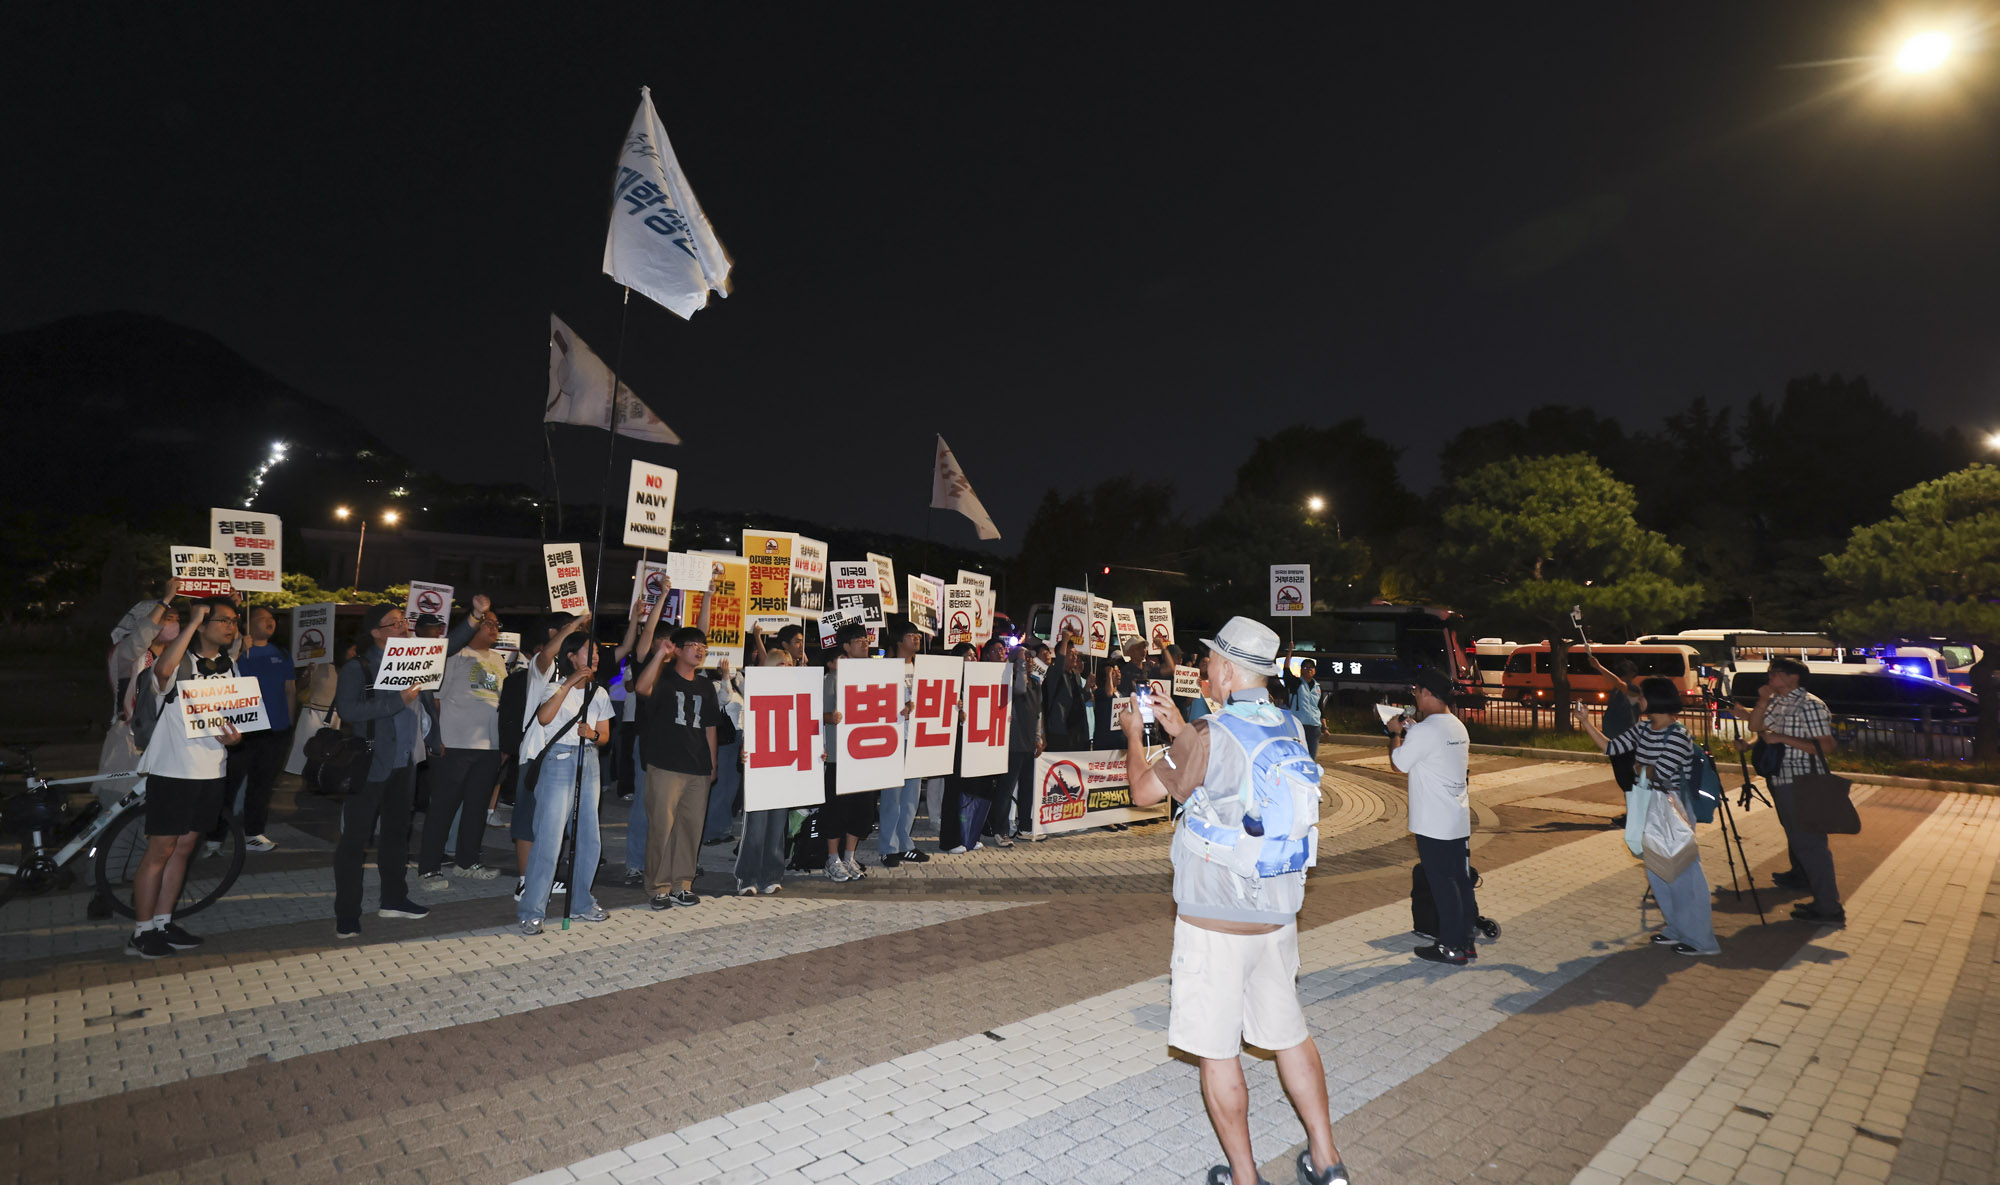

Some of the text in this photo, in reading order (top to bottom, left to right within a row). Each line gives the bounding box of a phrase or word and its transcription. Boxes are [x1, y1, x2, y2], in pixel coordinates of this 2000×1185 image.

[645, 473, 663, 489] NO
[636, 490, 668, 508] NAVY
[645, 510, 656, 521] TO
[218, 520, 266, 535] 침략을
[630, 522, 667, 536] HORMUZ!
[233, 536, 275, 550] 멈춰라!
[546, 550, 574, 568] 침략을
[749, 555, 772, 564] 이재명
[795, 558, 823, 573] 파병 요구
[233, 568, 275, 581] 멈춰라!
[557, 566, 581, 579] 멈춰라!
[840, 566, 867, 577] 미국의
[550, 580, 578, 599] 전쟁을
[794, 577, 812, 594] 거부
[836, 579, 875, 589] 파병 압박
[560, 596, 585, 609] 멈춰라!
[750, 597, 788, 611] 거부하
[801, 592, 821, 609] 하라!
[387, 645, 444, 656] DO NOT JOIN
[383, 660, 434, 671] A WAR OF
[1332, 661, 1363, 675] 경찰
[182, 684, 238, 699] NO NAVAL
[186, 696, 260, 715] DEPLOYMENT
[674, 690, 703, 729] 11
[189, 720, 205, 730] TO
[750, 679, 1009, 772] 파 병 반 대
[1088, 788, 1131, 809] 파병반대
[1041, 802, 1085, 822] 파병반대
